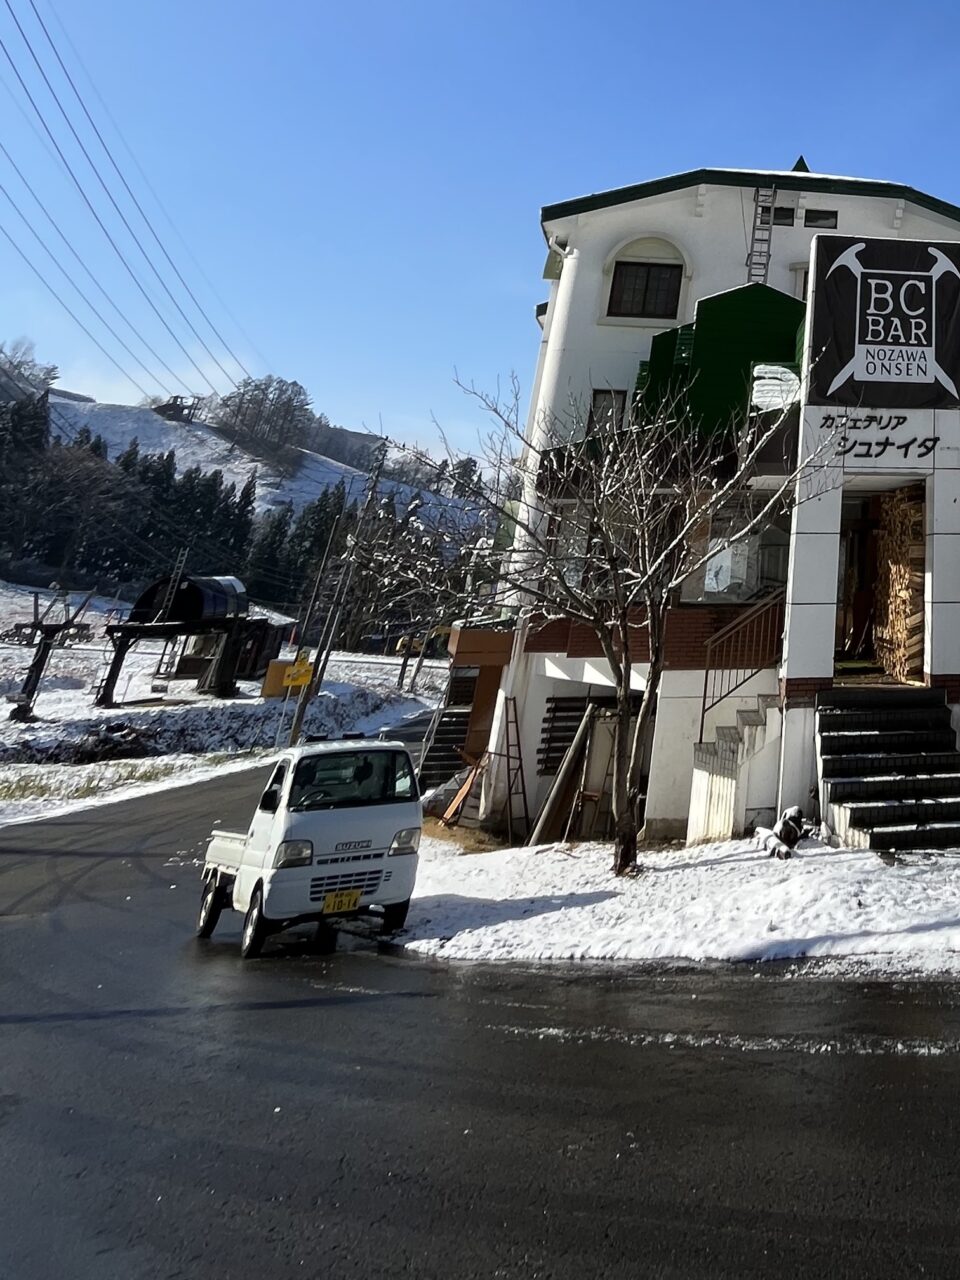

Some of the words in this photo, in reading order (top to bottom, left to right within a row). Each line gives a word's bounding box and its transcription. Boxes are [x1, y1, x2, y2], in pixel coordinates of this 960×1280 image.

[866, 278, 926, 316] BC
[865, 315, 928, 345] BAR
[865, 348, 928, 363] NOZAWA
[865, 361, 928, 377] ONSEN
